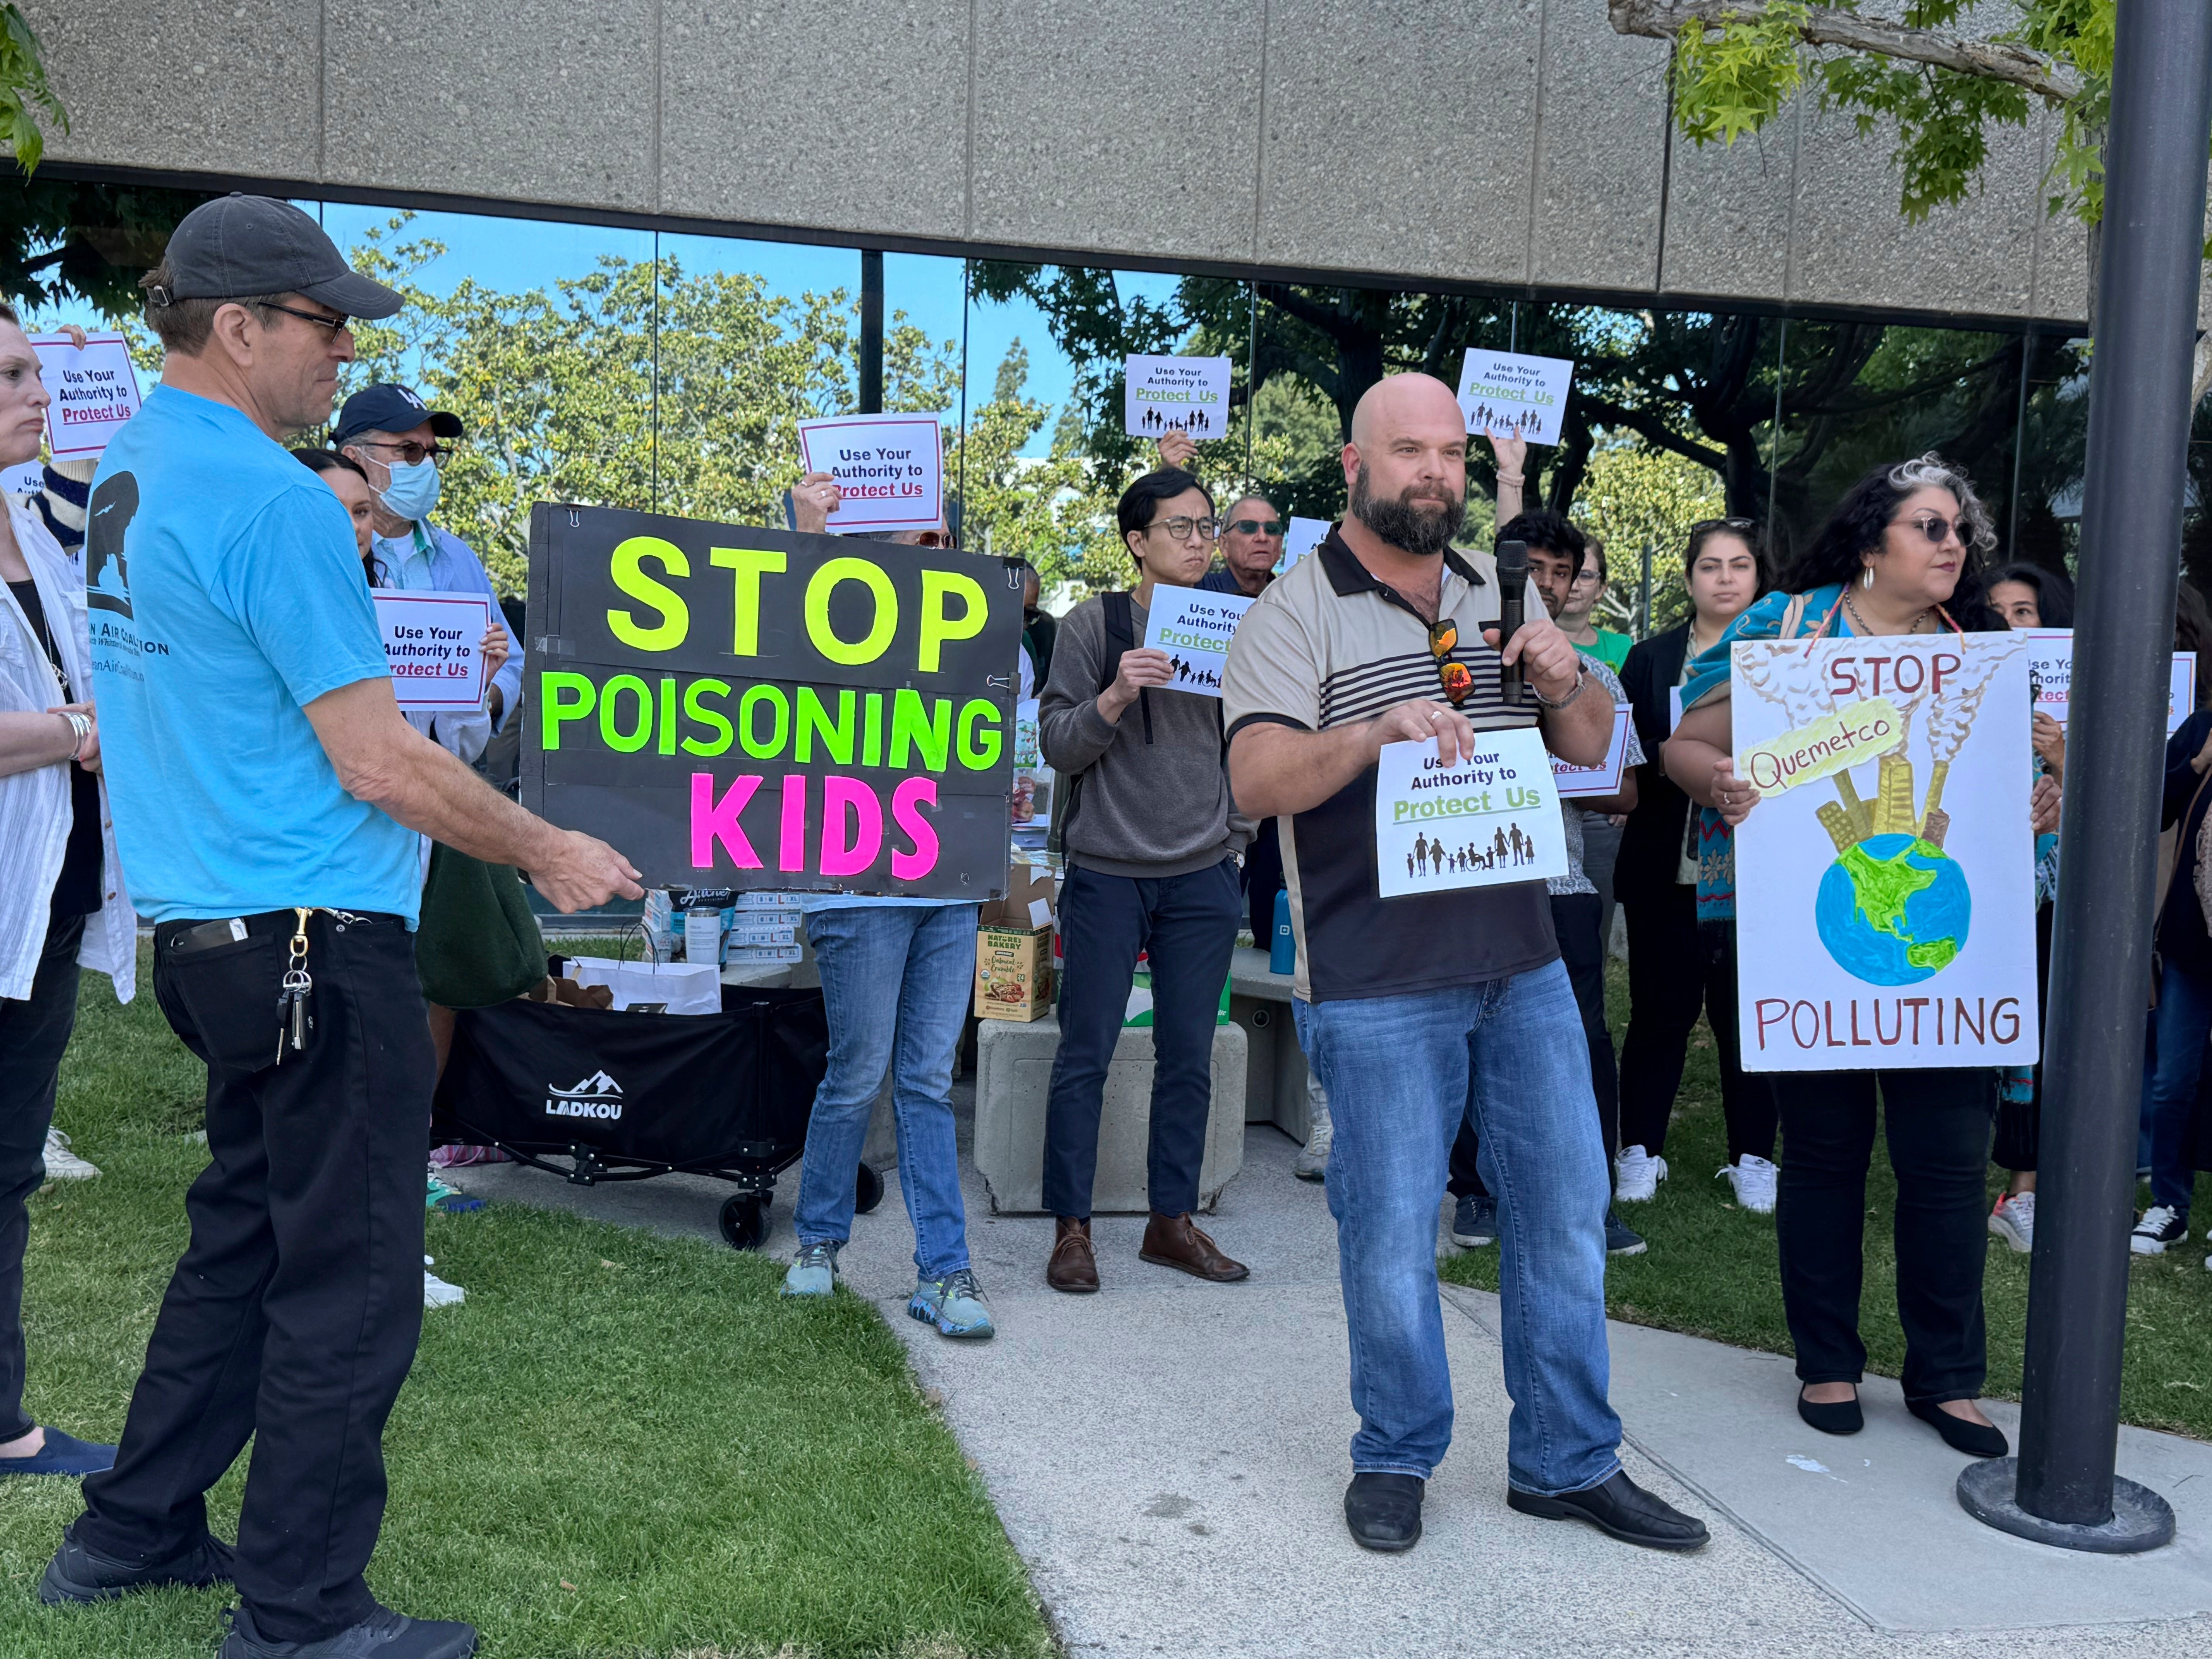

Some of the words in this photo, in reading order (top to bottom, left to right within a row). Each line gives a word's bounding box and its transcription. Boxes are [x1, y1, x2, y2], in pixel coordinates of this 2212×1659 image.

[63, 370, 84, 383] Use
[84, 370, 115, 382] Your
[1493, 362, 1513, 373] Use
[1517, 366, 1540, 376] Your
[1147, 377, 1195, 388] Authority
[1483, 372, 1532, 387] Authority
[1535, 379, 1546, 387] to
[60, 386, 113, 402] Authority
[116, 385, 127, 397] to
[397, 388, 428, 410] LA
[1136, 387, 1191, 401] Protect
[1199, 390, 1218, 402] Us
[1470, 382, 1526, 400] Protect
[1534, 390, 1554, 405] Us
[62, 404, 114, 422] Protect
[116, 404, 131, 417] Us
[839, 449, 871, 461] Use
[876, 448, 912, 460] Your
[831, 464, 903, 480] Authority
[908, 464, 923, 476] to
[902, 482, 923, 495] Us
[607, 536, 988, 673] STOP
[1190, 603, 1215, 616] Use
[1220, 608, 1244, 621] You
[395, 626, 424, 639] Use
[429, 627, 463, 640] Your
[1159, 627, 1231, 652] Protect
[384, 643, 452, 660] Authority
[456, 645, 471, 657] to
[390, 662, 442, 676] rotect
[447, 663, 468, 677] Us
[2032, 661, 2050, 670] se
[2055, 659, 2072, 669] Yo
[1831, 653, 1961, 696] STOP
[2038, 690, 2070, 701] tect
[541, 671, 1001, 773] POISONING
[1750, 720, 1890, 790] Quemetco
[1424, 757, 1443, 770] Us
[1411, 769, 1494, 790] Authority
[1499, 768, 1516, 780] to
[1394, 791, 1492, 821] Protect
[1506, 787, 1541, 808] Us
[690, 773, 939, 881] KIDS
[778, 894, 785, 905] L
[778, 914, 785, 924] L
[770, 933, 777, 943] L
[988, 941, 1022, 950] BAKERY
[777, 948, 784, 958] L
[991, 964, 1015, 973] Crumble
[1755, 997, 2021, 1051] POLLUTING
[546, 1099, 623, 1120] LADKOU
